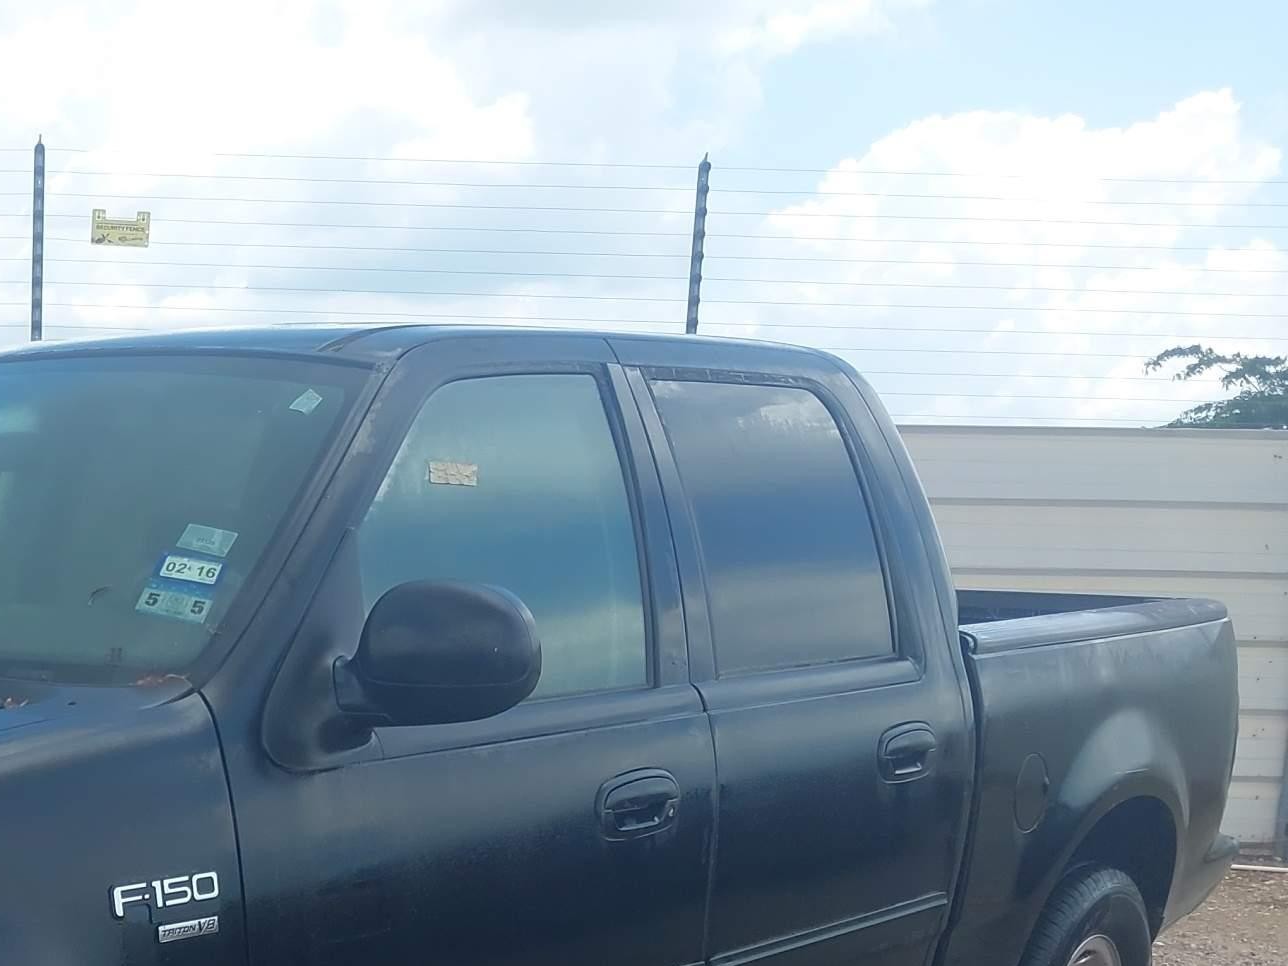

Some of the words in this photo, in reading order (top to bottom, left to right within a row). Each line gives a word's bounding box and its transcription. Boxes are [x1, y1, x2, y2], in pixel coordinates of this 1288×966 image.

[95, 224, 125, 232] SECURITY
[165, 561, 188, 574] 02
[197, 565, 217, 579] 16
[145, 592, 161, 607] 5
[190, 599, 206, 615] 5
[161, 924, 196, 938] TRITON
[197, 918, 217, 934] V8
